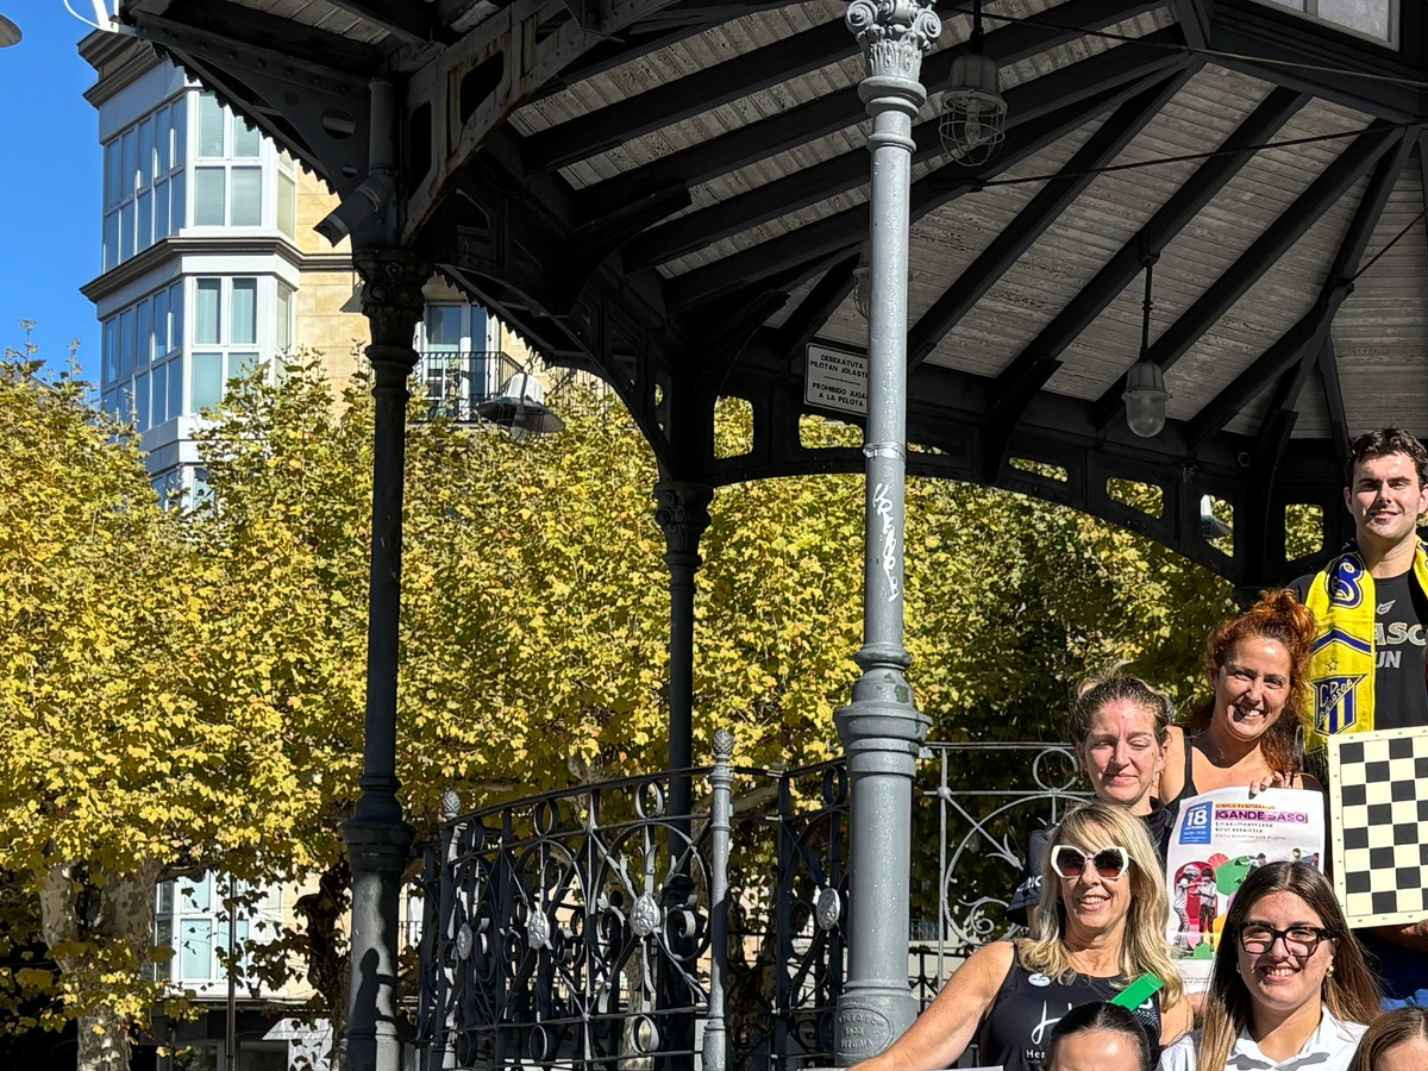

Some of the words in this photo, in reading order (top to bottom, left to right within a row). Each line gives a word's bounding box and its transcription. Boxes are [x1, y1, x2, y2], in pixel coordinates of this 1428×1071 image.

[810, 361, 838, 372] PILOTAN
[820, 354, 864, 369] DEBEKATUTA
[812, 382, 847, 395] PROHIBIDO
[838, 396, 864, 406] PELOTA
[1186, 808, 1208, 826] 18
[1215, 809, 1264, 820] IGANDE
